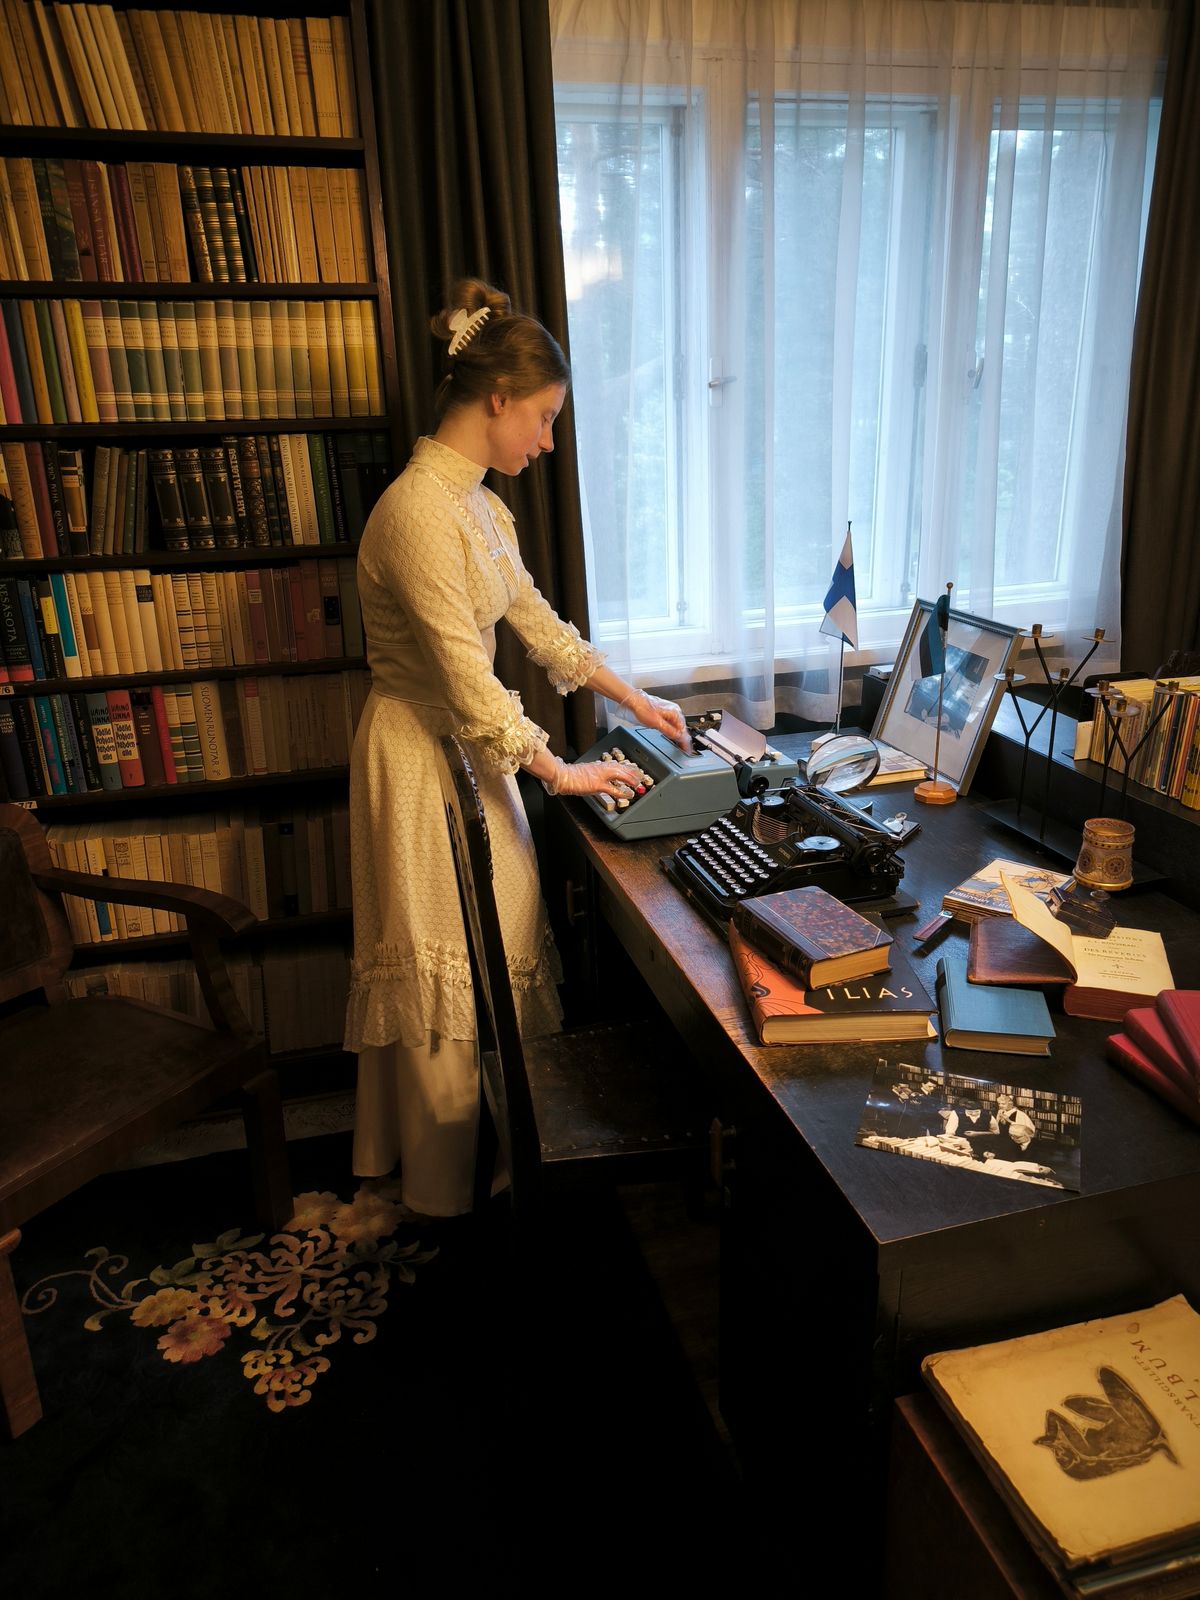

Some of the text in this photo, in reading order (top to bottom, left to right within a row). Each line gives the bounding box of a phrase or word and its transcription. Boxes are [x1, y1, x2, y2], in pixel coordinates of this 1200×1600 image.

[200, 686, 220, 766] SUOMEN RUNOTAR
[826, 986, 913, 1000] ILIAS
[1129, 1339, 1200, 1402] LBUM
